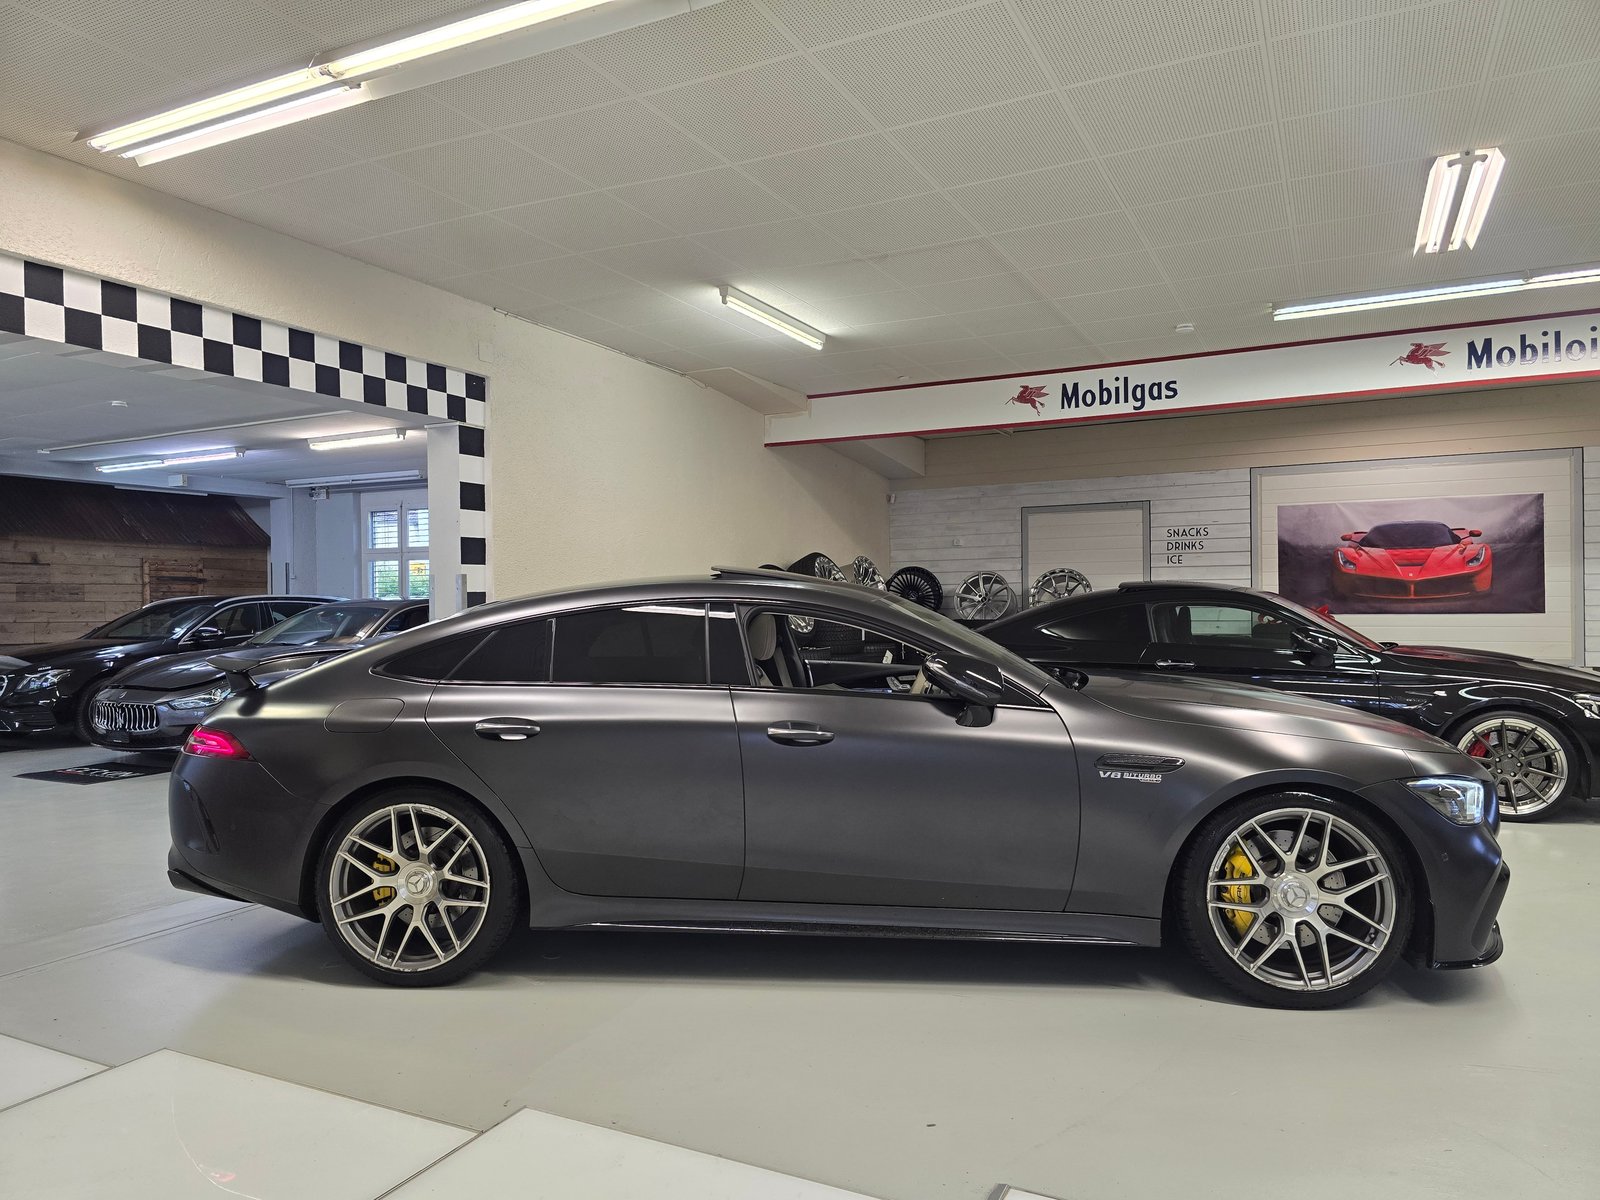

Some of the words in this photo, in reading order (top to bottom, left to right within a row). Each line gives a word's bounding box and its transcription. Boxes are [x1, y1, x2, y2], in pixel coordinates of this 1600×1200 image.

[1061, 376, 1178, 410] Mobilgas
[1166, 527, 1209, 538] SNACKS
[1166, 541, 1204, 551] DRINKS
[1166, 555, 1183, 565] ICE
[1099, 770, 1121, 779] V8
[1123, 772, 1162, 781] BITURBO
